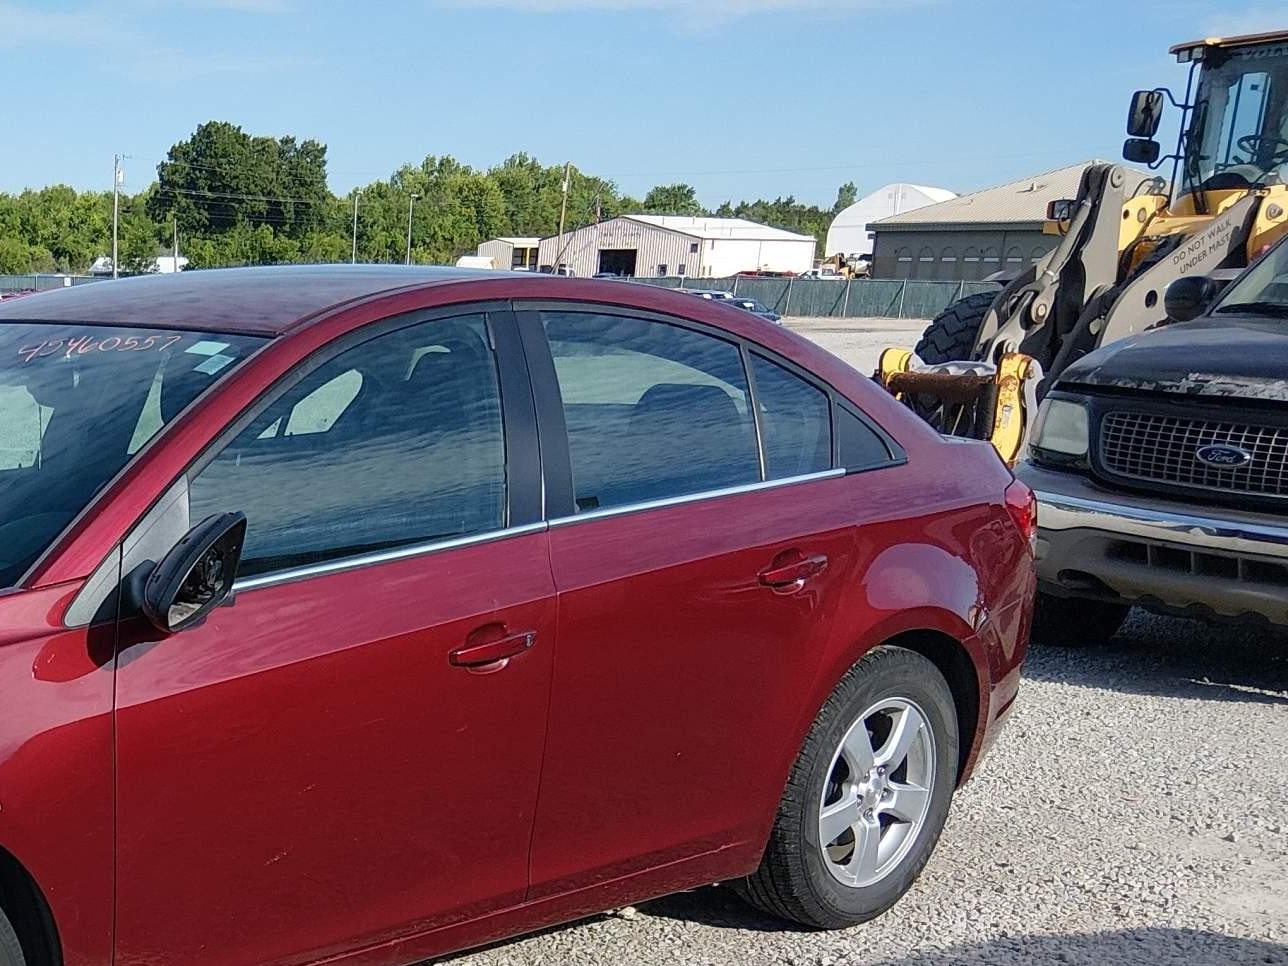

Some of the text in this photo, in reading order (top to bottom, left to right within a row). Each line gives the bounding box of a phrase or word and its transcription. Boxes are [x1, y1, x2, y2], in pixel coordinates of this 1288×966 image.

[1173, 218, 1232, 265] DO NOT WALK
[1179, 232, 1231, 274] UNDER MAST
[17, 335, 182, 363] 45460557
[1207, 450, 1237, 463] Ford
